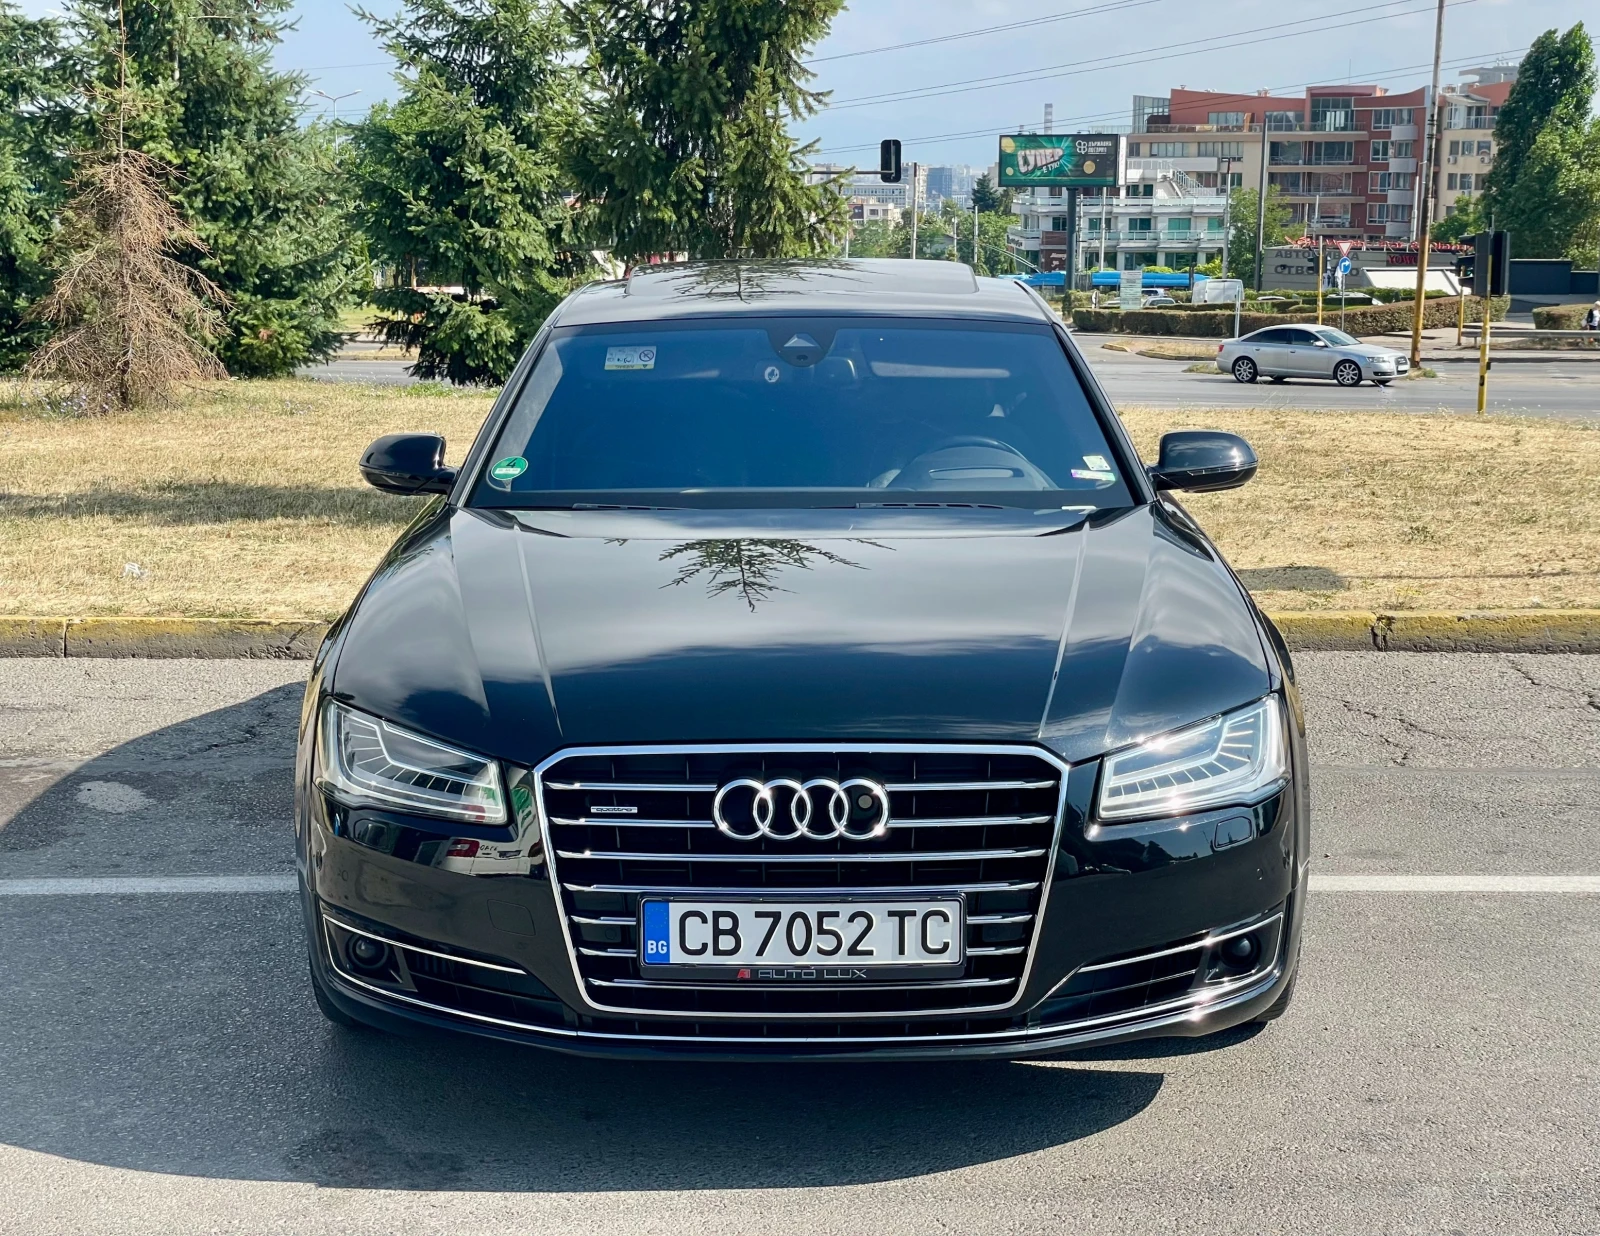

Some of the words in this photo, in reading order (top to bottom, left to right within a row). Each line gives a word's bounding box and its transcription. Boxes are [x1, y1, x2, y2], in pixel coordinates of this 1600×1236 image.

[1017, 148, 1064, 173] СУПЕР
[506, 457, 518, 468] 4
[679, 909, 743, 957] CB
[754, 909, 875, 957] 7052
[887, 909, 951, 957] TC
[647, 939, 668, 955] BG
[758, 968, 816, 979] AUTO
[824, 968, 867, 979] LUX
